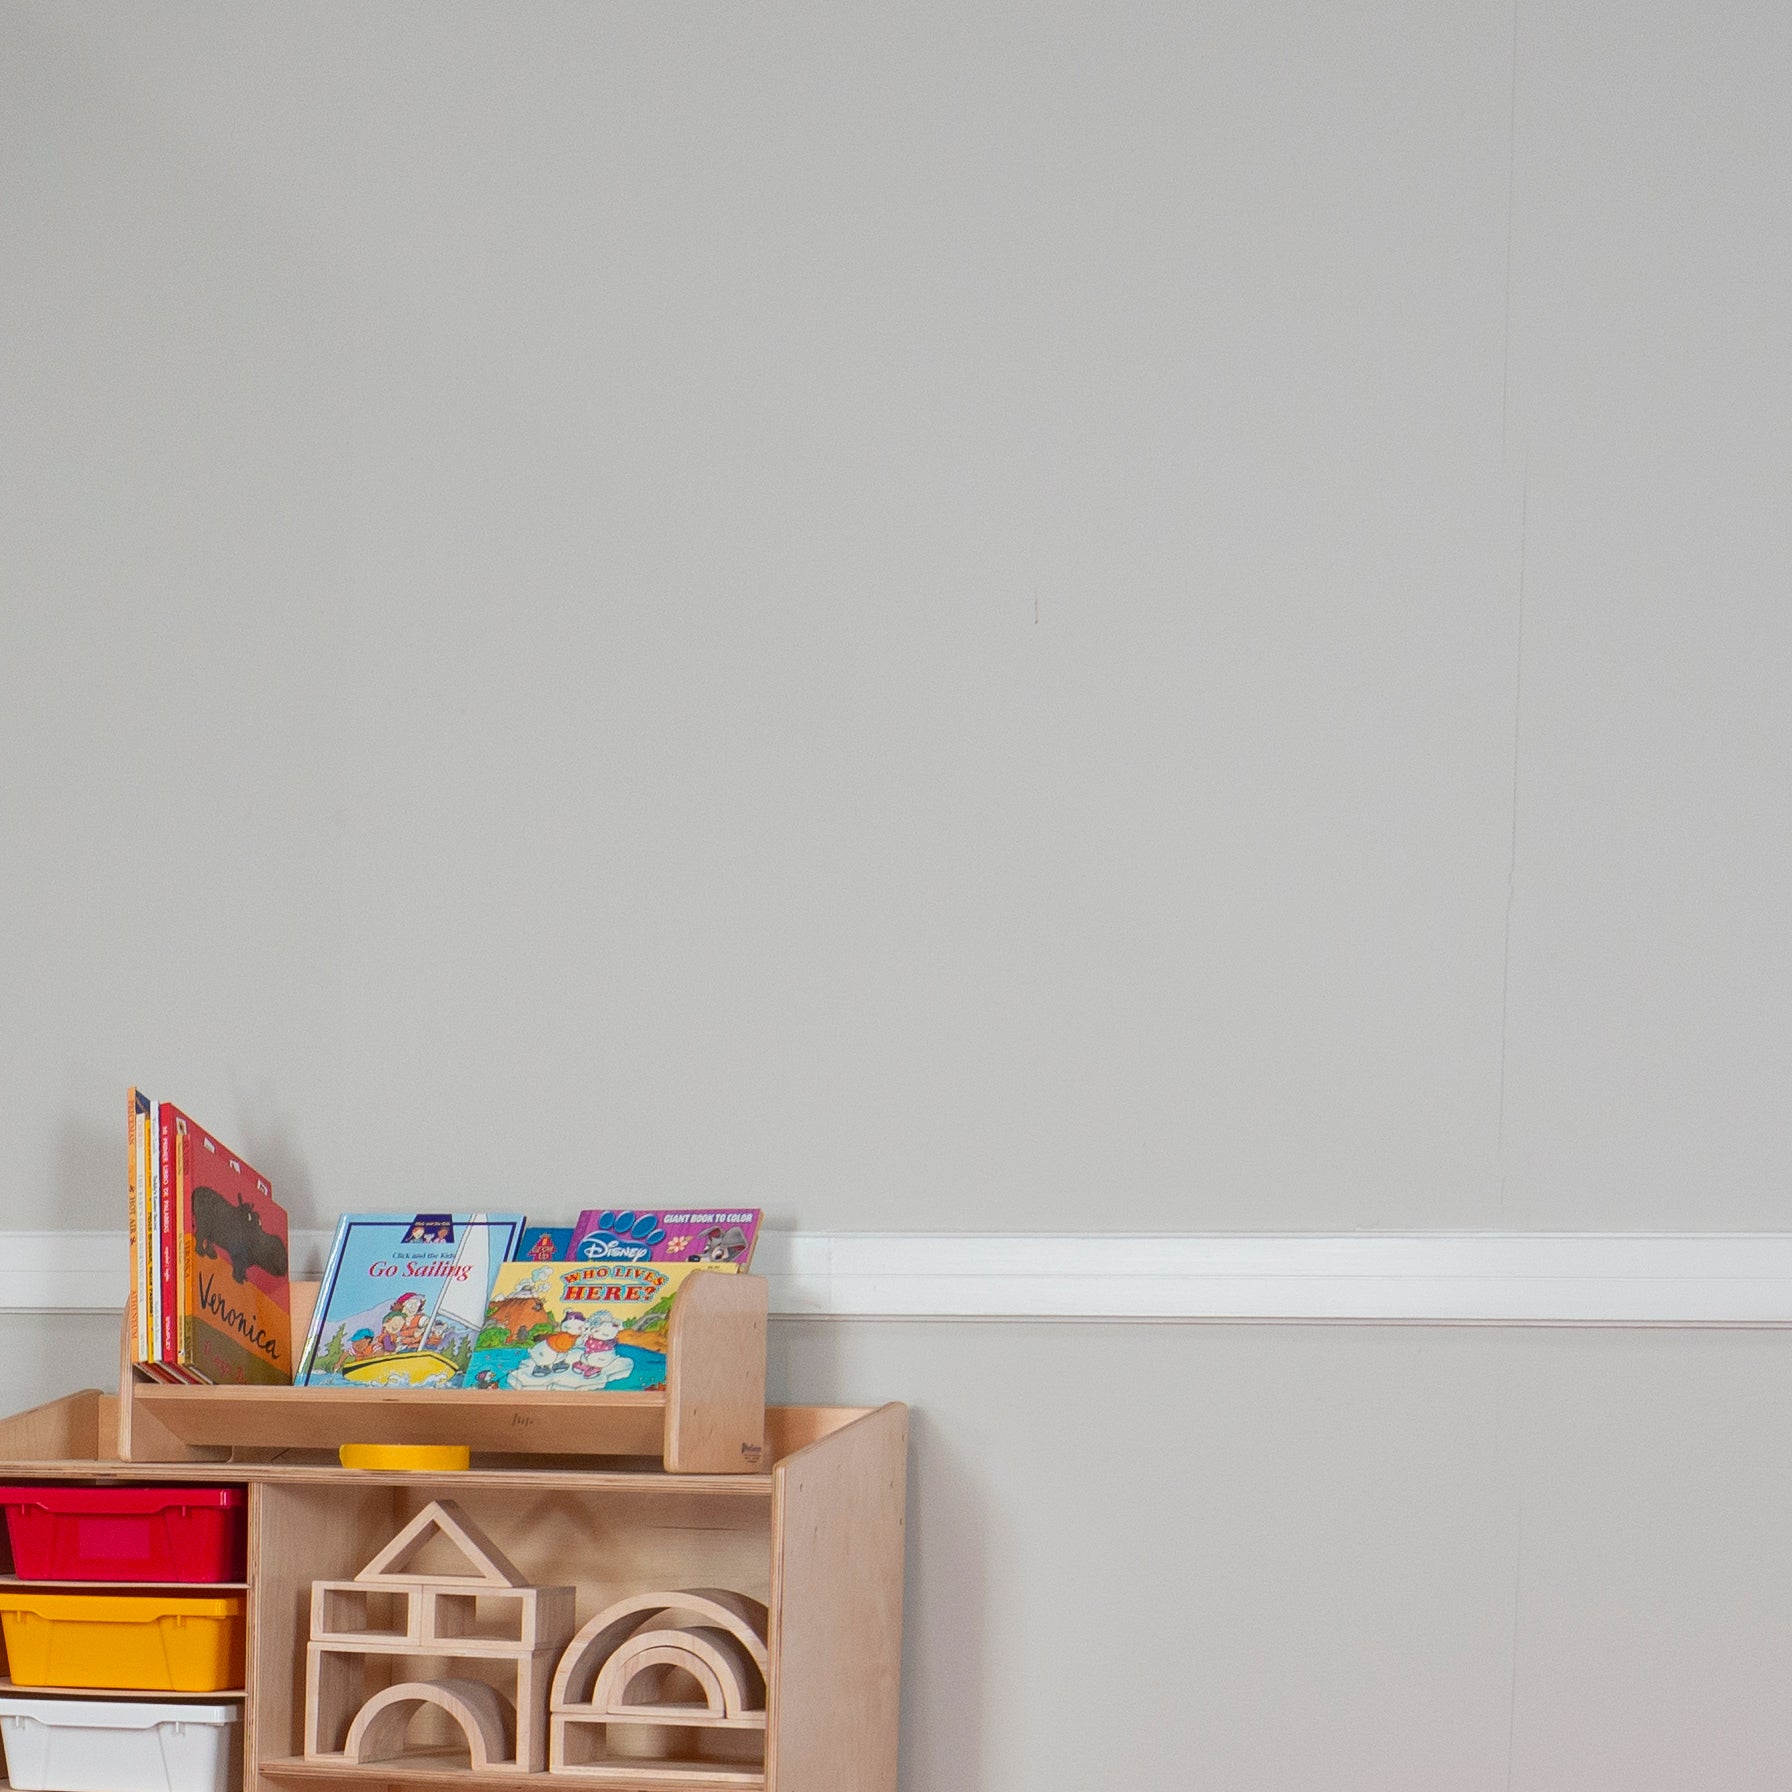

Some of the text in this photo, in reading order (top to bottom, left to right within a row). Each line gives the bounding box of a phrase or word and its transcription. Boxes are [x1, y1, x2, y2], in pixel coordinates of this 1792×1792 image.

[664, 1213, 753, 1223] GIANT BOOK TO COLOR
[369, 1260, 474, 1281] Go Sailing
[564, 1267, 666, 1286] WHO LIVES
[564, 1286, 657, 1301] HERE?
[198, 1271, 281, 1360] Veronica
